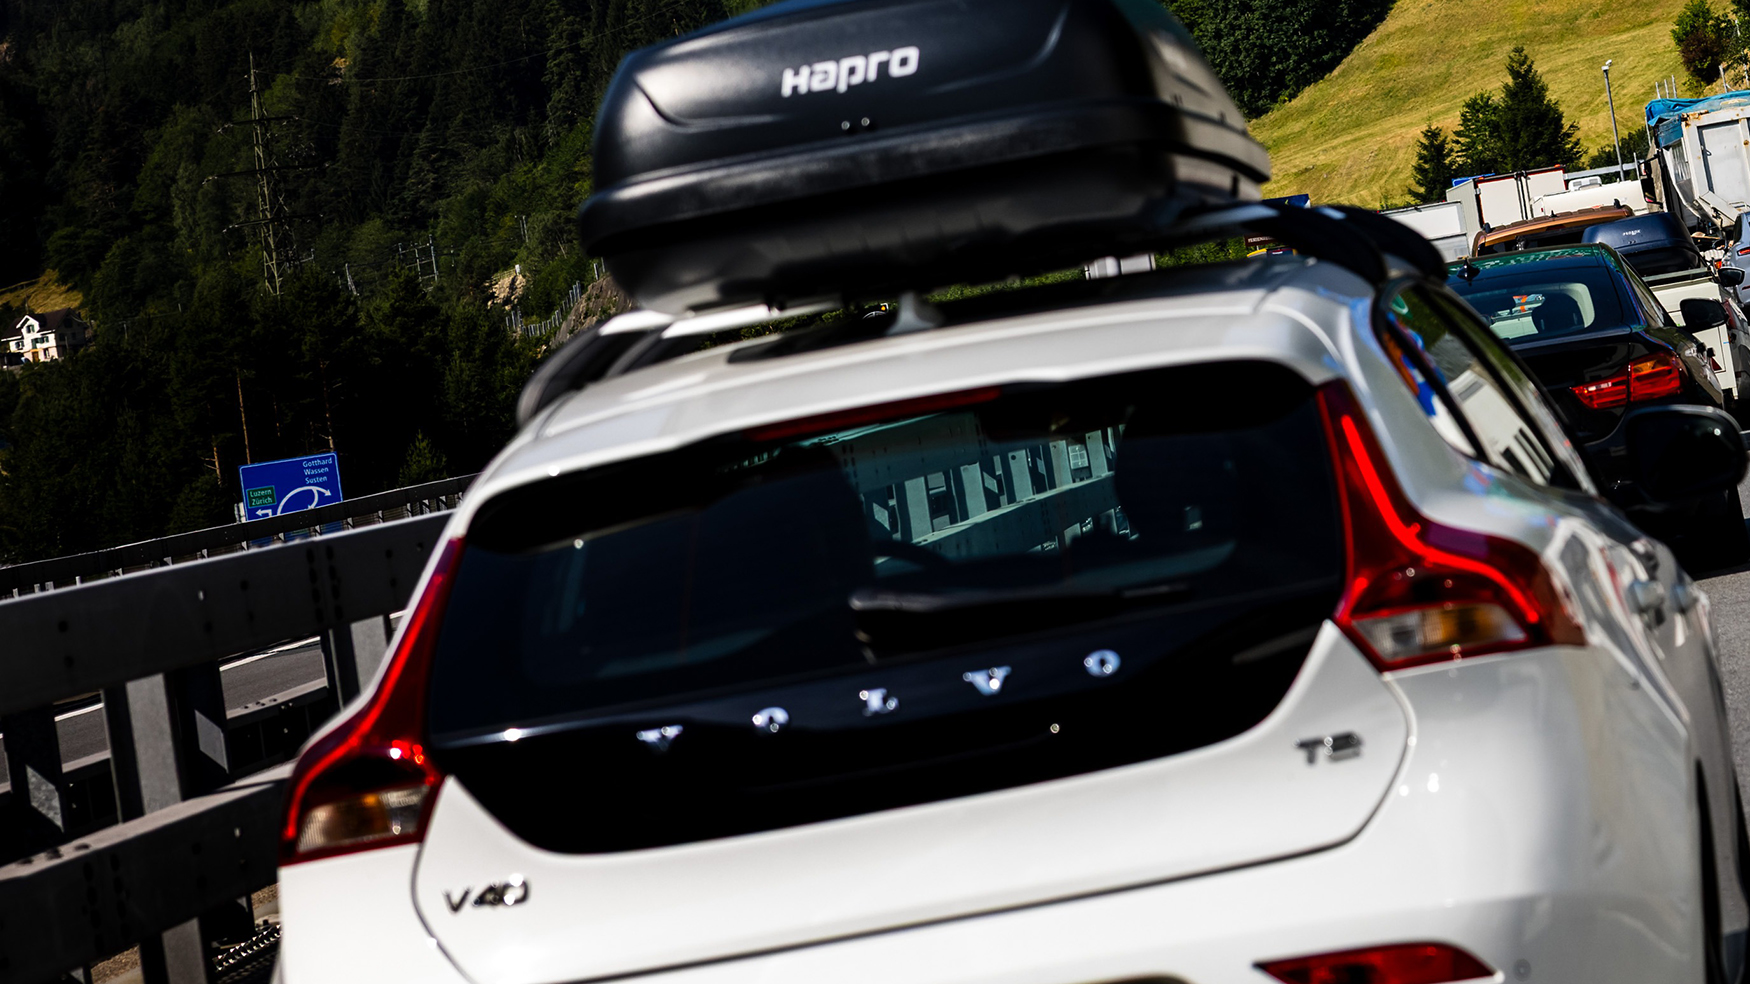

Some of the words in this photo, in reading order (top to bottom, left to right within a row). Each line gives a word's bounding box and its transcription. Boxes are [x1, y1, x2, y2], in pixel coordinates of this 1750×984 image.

[780, 46, 920, 98] Hapro
[302, 457, 333, 468] Gotthard
[303, 466, 329, 476] Wassen
[304, 476, 328, 485] Susten
[249, 489, 272, 498] Luzern
[251, 497, 273, 506] Zürich
[442, 874, 531, 913] V40
